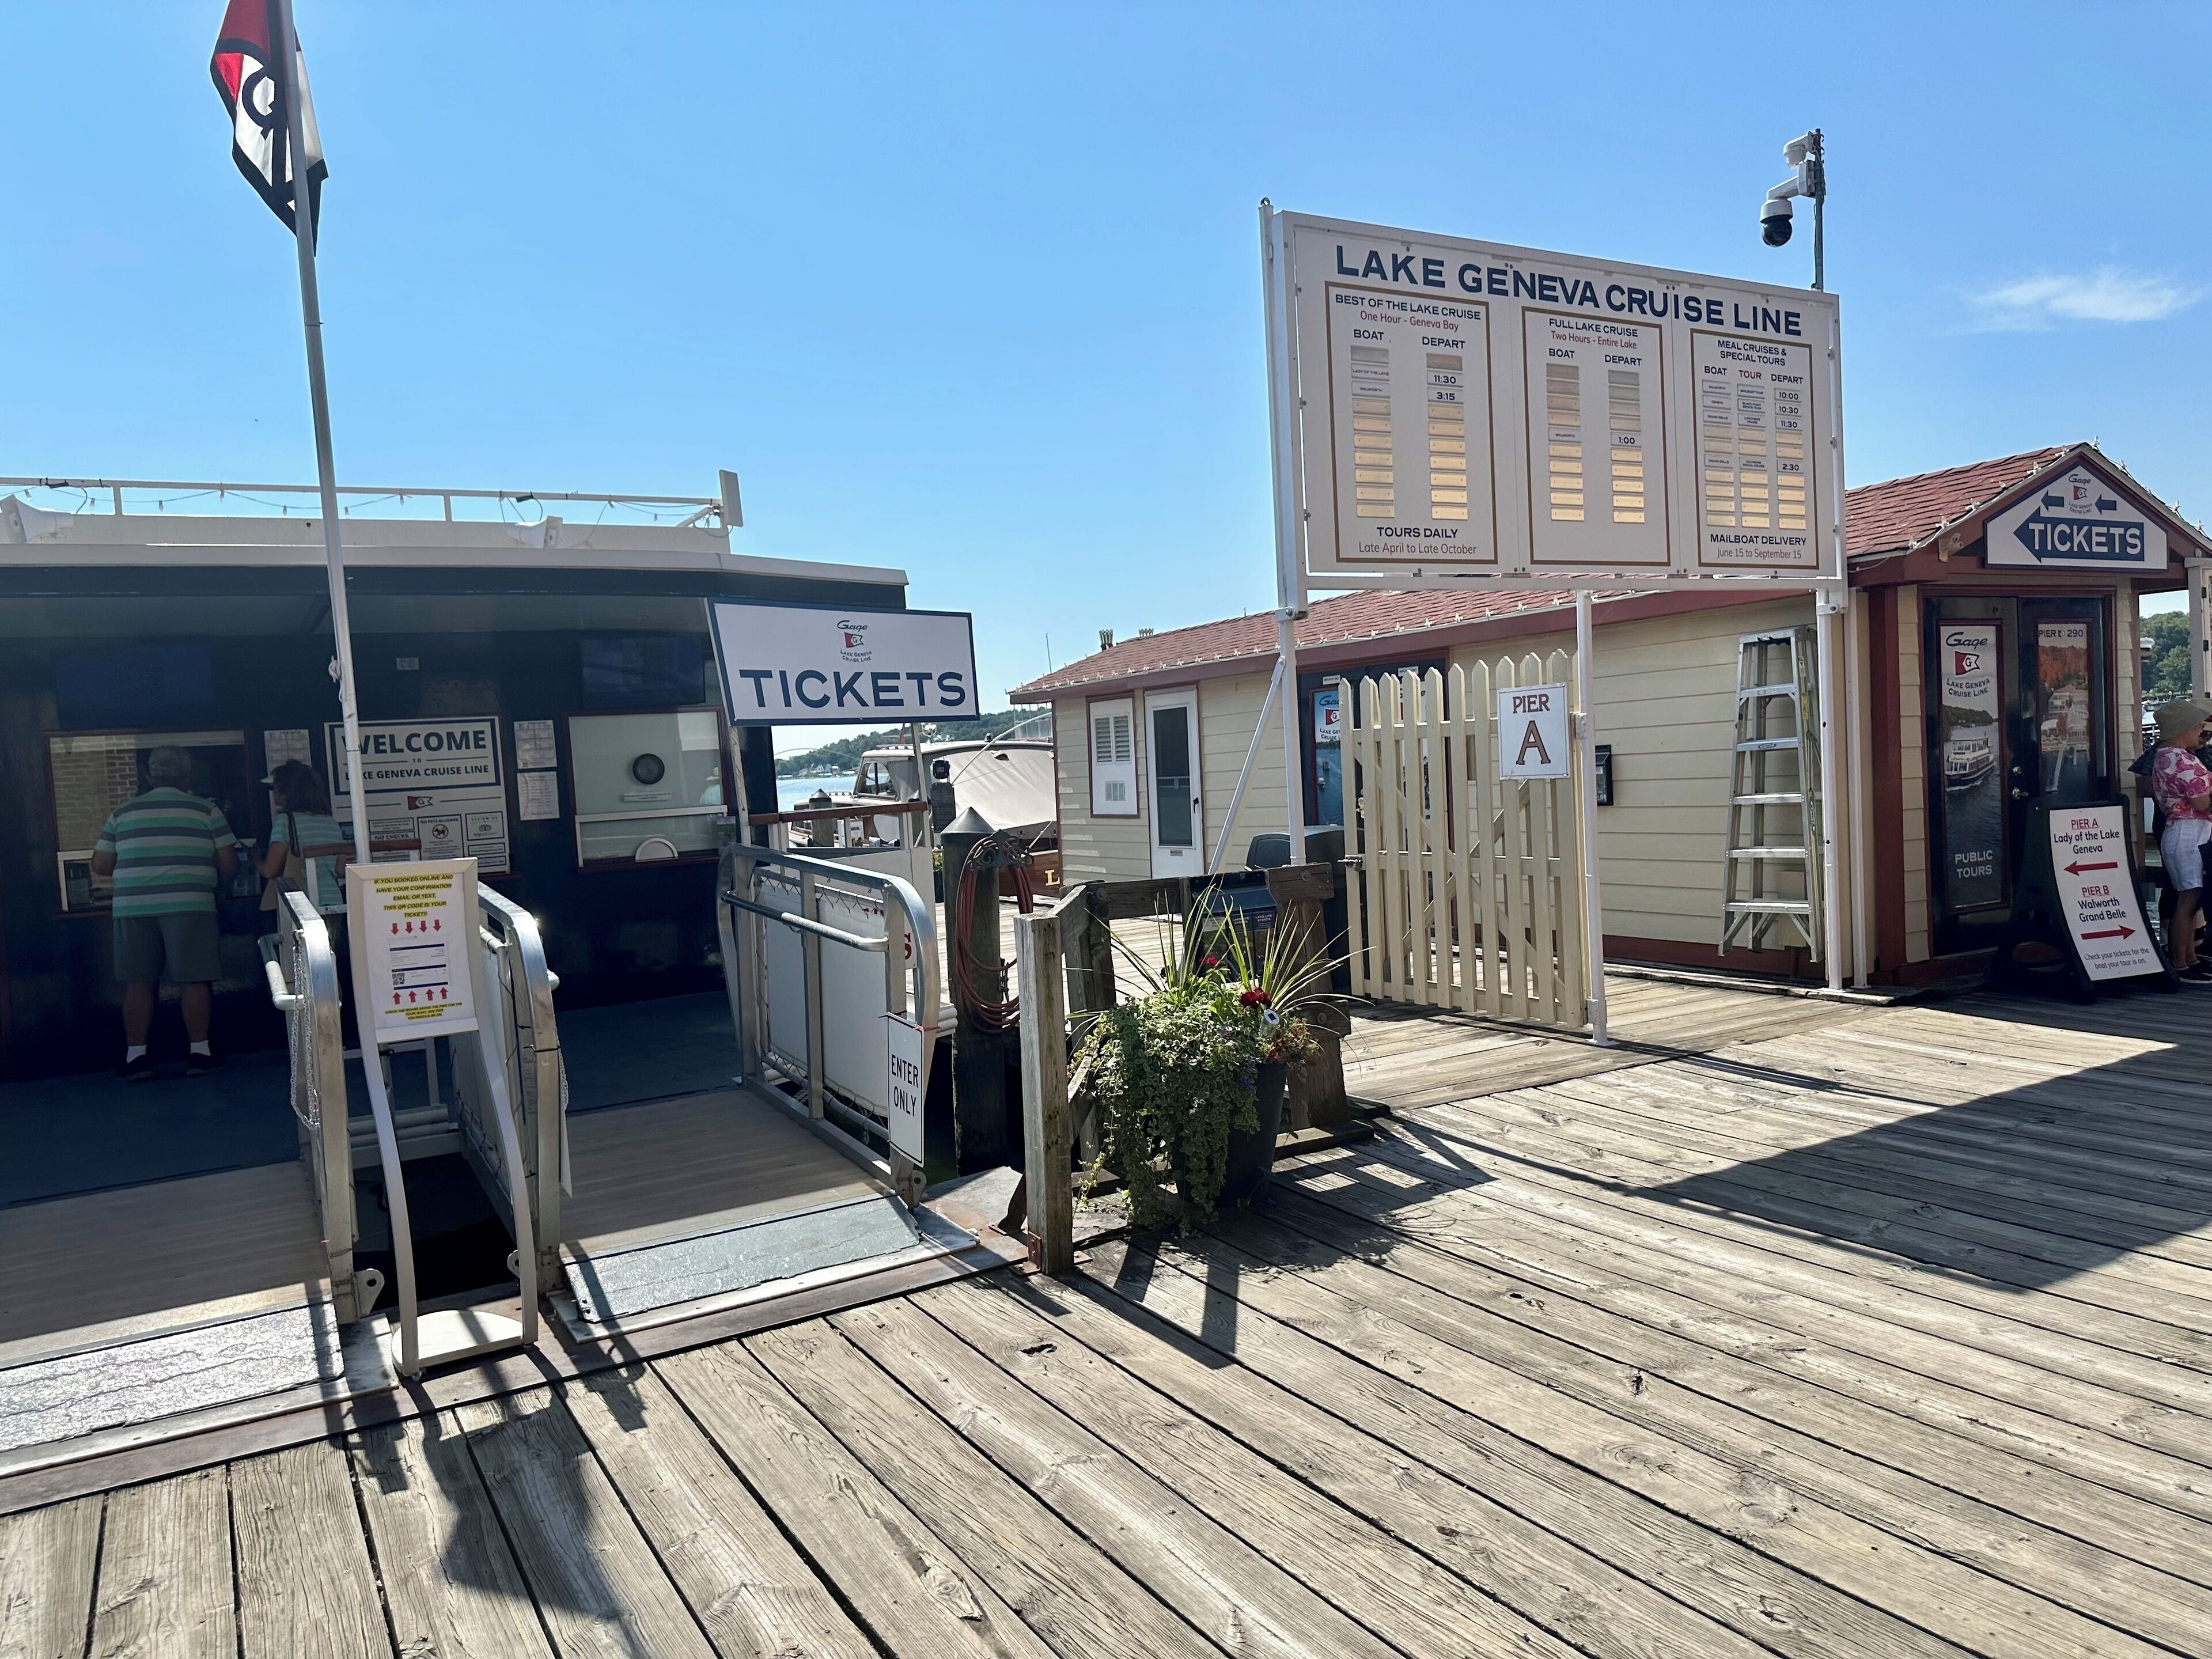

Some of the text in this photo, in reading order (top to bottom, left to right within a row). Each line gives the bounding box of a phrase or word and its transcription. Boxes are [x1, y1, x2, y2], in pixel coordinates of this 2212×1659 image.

[1336, 245, 1801, 336] LAKE GENEVA CRUISE LINE
[1336, 294, 1480, 320] BEST OF THE LAKE CRUISE
[1361, 310, 1377, 321] One
[1380, 313, 1401, 324] Hour
[1410, 317, 1440, 328] Geneva
[1444, 321, 1459, 332] Bay
[1354, 329, 1384, 340] BOAT
[1549, 319, 1638, 337] FULL LAKE CRUISE
[1422, 336, 1465, 349] DEPART
[1551, 331, 1566, 340] Two
[1569, 333, 1590, 344] Hours
[1598, 337, 1618, 347] Entire
[1620, 339, 1637, 349] Lake
[1549, 348, 1575, 358] BOAT
[1718, 340, 1741, 350] MEAL
[1743, 343, 1779, 355] CRUISES
[1605, 354, 1642, 366] DEPART
[1720, 351, 1786, 366] SPECIAL TOURS
[1704, 366, 1727, 376] BOAT
[1738, 370, 1762, 380] TOUR
[1434, 375, 1456, 384] 11:30
[1771, 374, 1804, 384] DEPART
[1437, 392, 1455, 400] 3:15
[1779, 391, 1798, 400] 10:00
[1779, 406, 1798, 414] 10:30
[1618, 436, 1635, 444] 1:00
[2069, 474, 2091, 485] Gage
[1377, 527, 1458, 539] TOURS DAILY
[2028, 523, 2141, 555] TICKETS
[1710, 533, 1806, 547] MAILBOAT DELIVERY
[1359, 542, 1476, 555] Late April to Late October
[1717, 548, 1801, 560] June 15 to September 15
[837, 620, 868, 632] Gage
[2039, 630, 2056, 638] PIER
[1946, 632, 1987, 650] Gage
[1965, 657, 1972, 667] G
[738, 669, 966, 709] TICKETS
[1946, 678, 1990, 690] LAKE GENEVA
[1948, 688, 1988, 697] CRUISE LINE
[1512, 694, 1550, 714] PIER
[1516, 720, 1551, 765] A
[377, 769, 421, 779] GENEVA
[424, 766, 461, 776] CRUISE
[465, 765, 489, 774] LINE
[2071, 818, 2099, 829] PIER A
[2054, 830, 2120, 844] Lady of the Lake
[2073, 844, 2103, 854] Geneva
[1955, 850, 1993, 864] PUBLIC
[1956, 865, 1993, 878] TOURS
[2081, 885, 2109, 896] PIER B
[2078, 897, 2120, 910] Walworth
[2079, 909, 2127, 923] Grand Belle
[2084, 952, 2100, 961] Check
[2101, 952, 2113, 961] your
[2113, 950, 2131, 958] tickets
[2131, 948, 2139, 956] for
[2094, 961, 2107, 969] boat
[2107, 961, 2119, 970] your
[2120, 959, 2131, 968] tour
[891, 1054, 919, 1088] ENTER
[893, 1087, 916, 1117] ONLY
